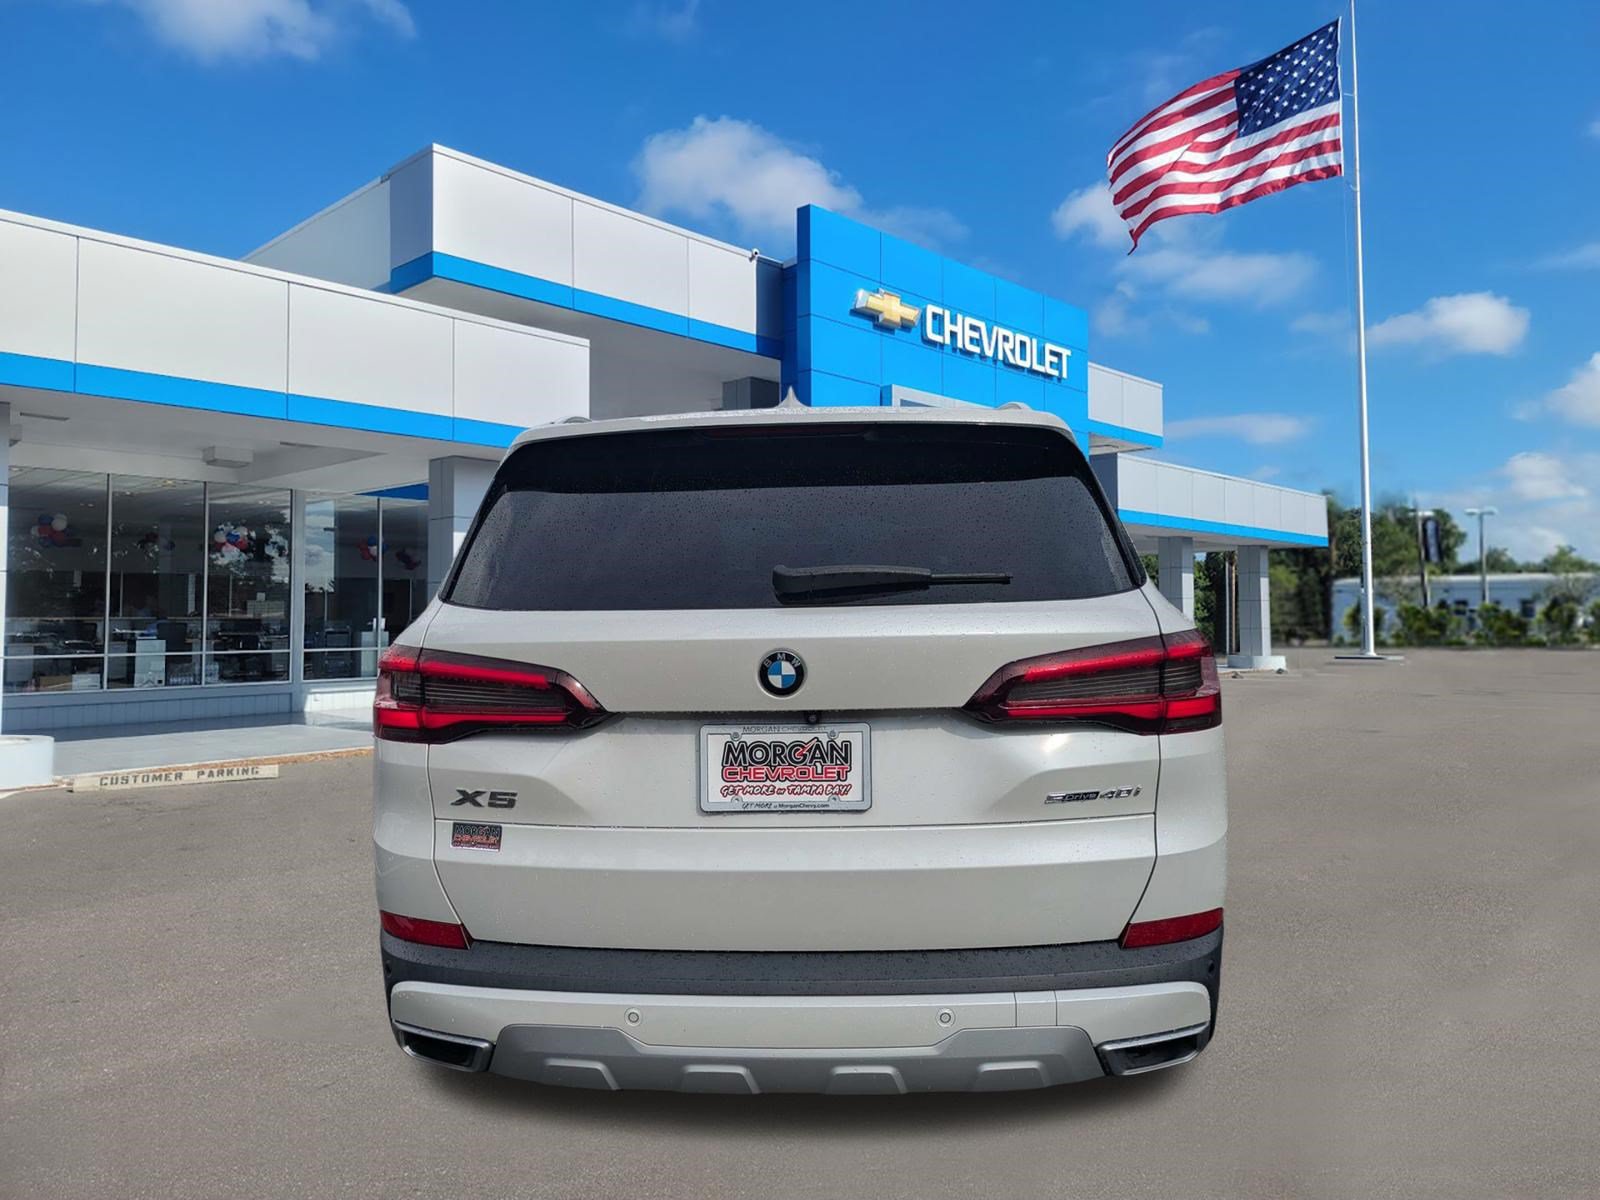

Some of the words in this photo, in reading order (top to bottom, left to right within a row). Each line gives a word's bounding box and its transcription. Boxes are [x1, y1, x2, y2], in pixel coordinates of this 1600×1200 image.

[924, 303, 1072, 380] CHEVROLET
[763, 652, 801, 668] BMW
[722, 738, 852, 767] MORGAN
[99, 771, 184, 787] CUSTOMER
[197, 766, 260, 779] PARKING
[722, 766, 851, 782] CHEVROLET
[450, 789, 518, 809] X5
[720, 785, 742, 797] GET
[742, 785, 775, 795] MORE
[787, 784, 824, 796] TAMPA
[825, 784, 852, 796] BAY!
